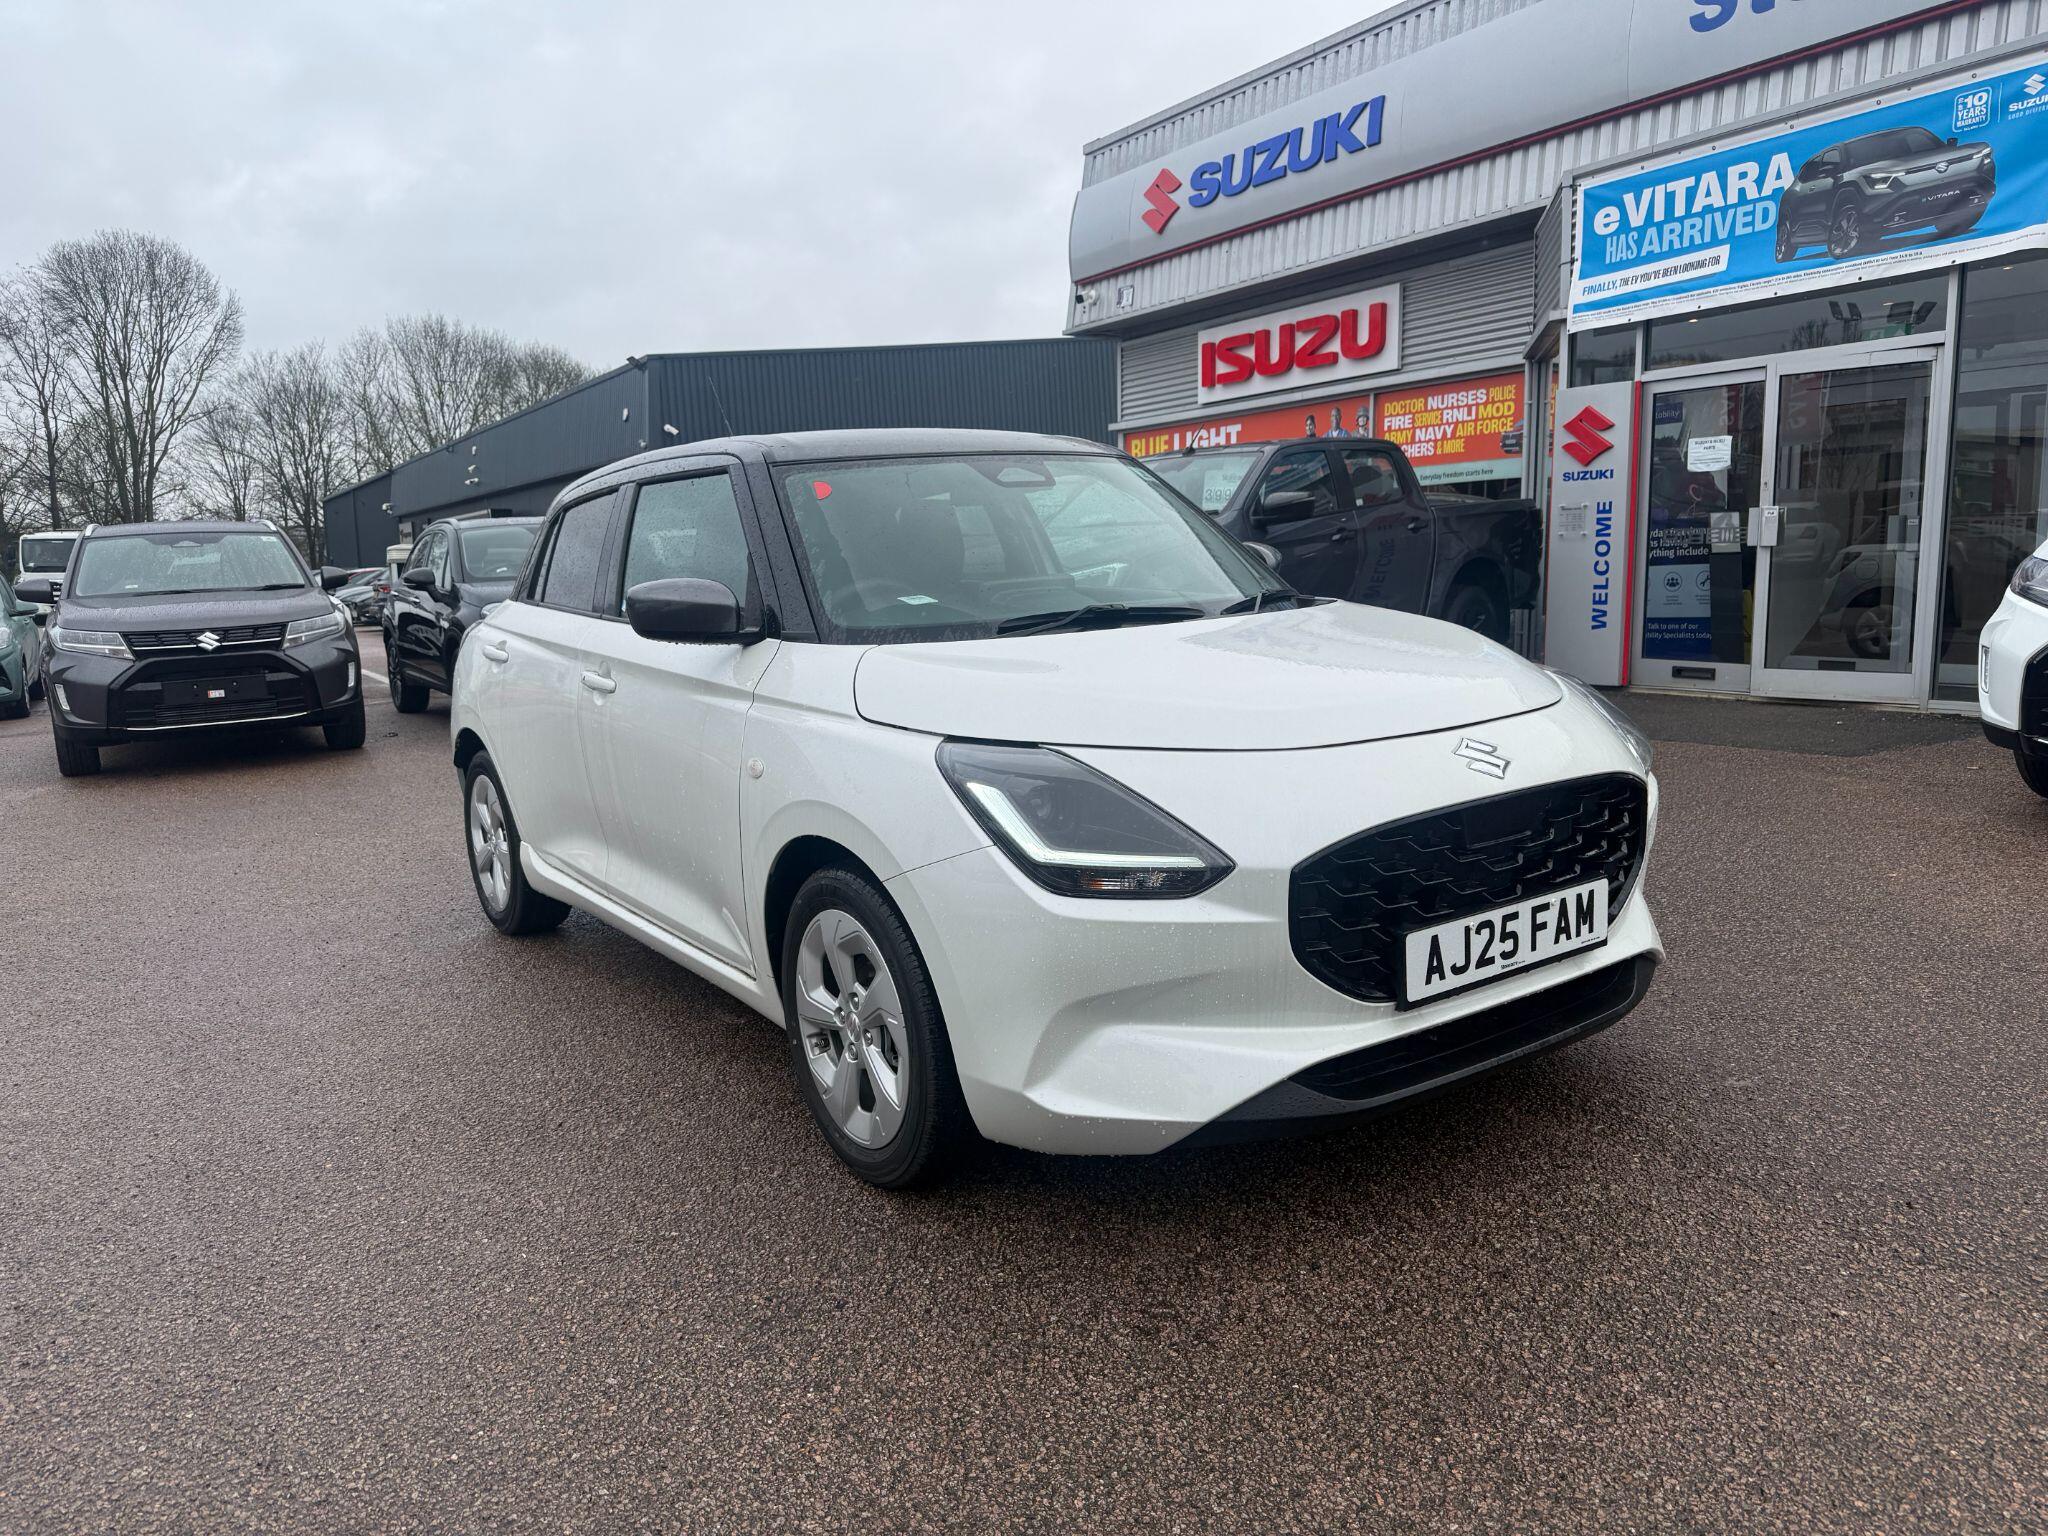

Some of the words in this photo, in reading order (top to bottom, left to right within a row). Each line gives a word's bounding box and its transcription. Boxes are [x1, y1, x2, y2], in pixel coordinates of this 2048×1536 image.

[1957, 104, 1987, 121] YEARS
[1964, 92, 1988, 109] 10
[1188, 95, 1386, 208] SUZUKI
[1605, 230, 1639, 265] HAS
[1640, 200, 1777, 257] ARRIVED
[1582, 280, 1618, 296] FINALLY,
[1619, 275, 1632, 288] THE
[1631, 274, 1640, 285] EV
[1661, 264, 1679, 278] BEEN
[1678, 258, 1708, 275] LOOKING
[1706, 254, 1721, 268] FOR
[1201, 302, 1388, 388] ISUZU
[1384, 397, 1425, 416] DOCTOR
[1427, 389, 1487, 410] NURSES
[1489, 384, 1517, 401] POLICE
[1384, 414, 1413, 431] FIRE
[1414, 410, 1442, 428] SERVICE
[1442, 406, 1476, 424] RNLI
[1478, 401, 1515, 419] MOD
[1415, 425, 1455, 442] NAVY
[1456, 420, 1476, 437] AIR
[1477, 416, 1515, 434] FORCE
[1436, 442, 1442, 455] &
[1443, 438, 1465, 454] MORE
[1443, 470, 1465, 479] freedom
[1465, 469, 1481, 477] starts
[1563, 469, 1614, 482] SUZUKI
[1591, 500, 1613, 630] WELCOME
[1663, 631, 1695, 640] Specialists
[1424, 911, 1519, 986] AJ25
[1531, 889, 1595, 952] FAM
